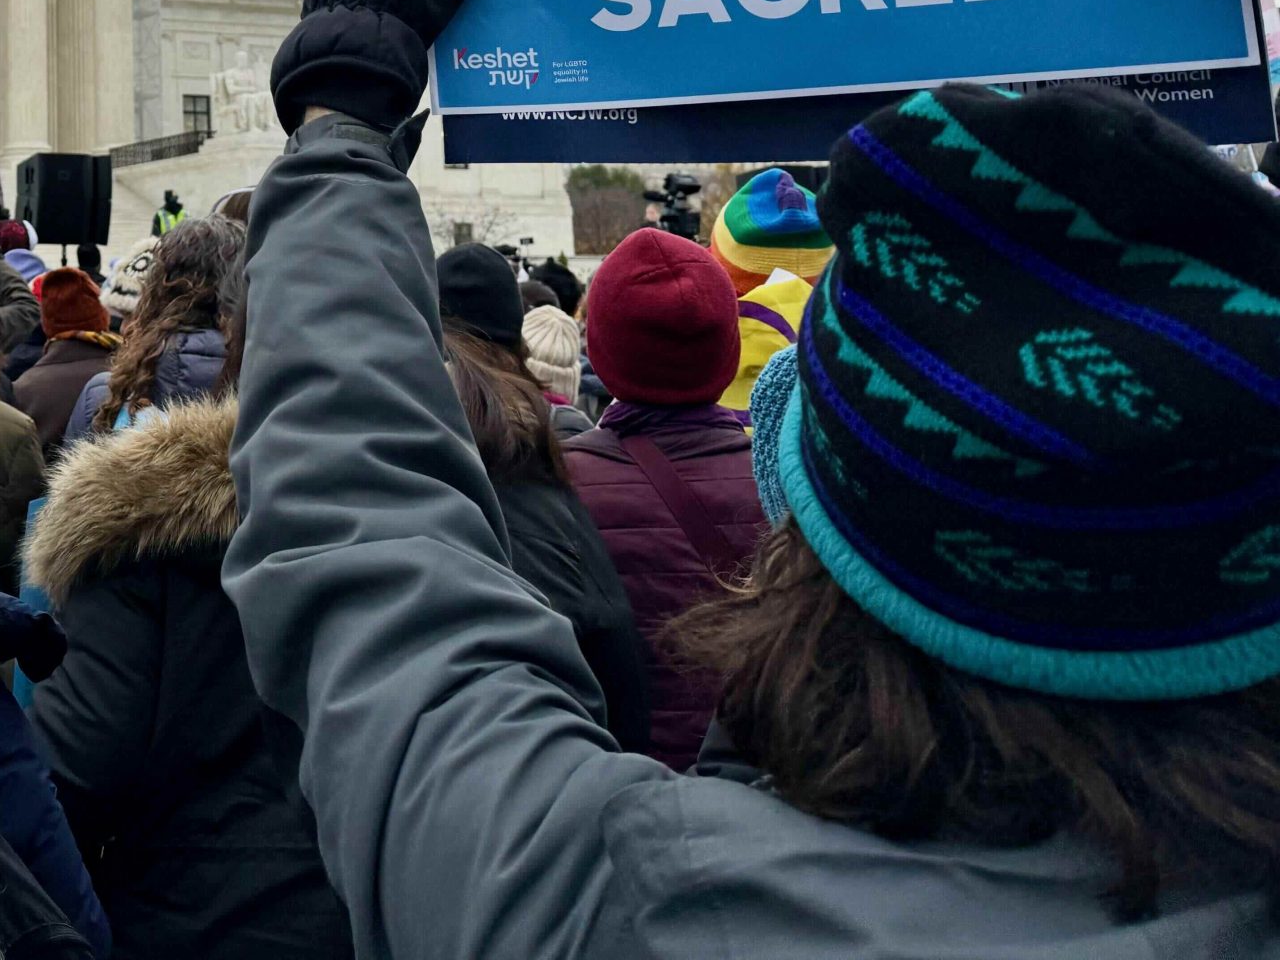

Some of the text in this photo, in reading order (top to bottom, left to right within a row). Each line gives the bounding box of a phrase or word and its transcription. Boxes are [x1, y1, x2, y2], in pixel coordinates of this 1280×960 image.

[453, 47, 539, 70] Keshet
[488, 69, 539, 90] קשת
[1134, 87, 1214, 104] Women
